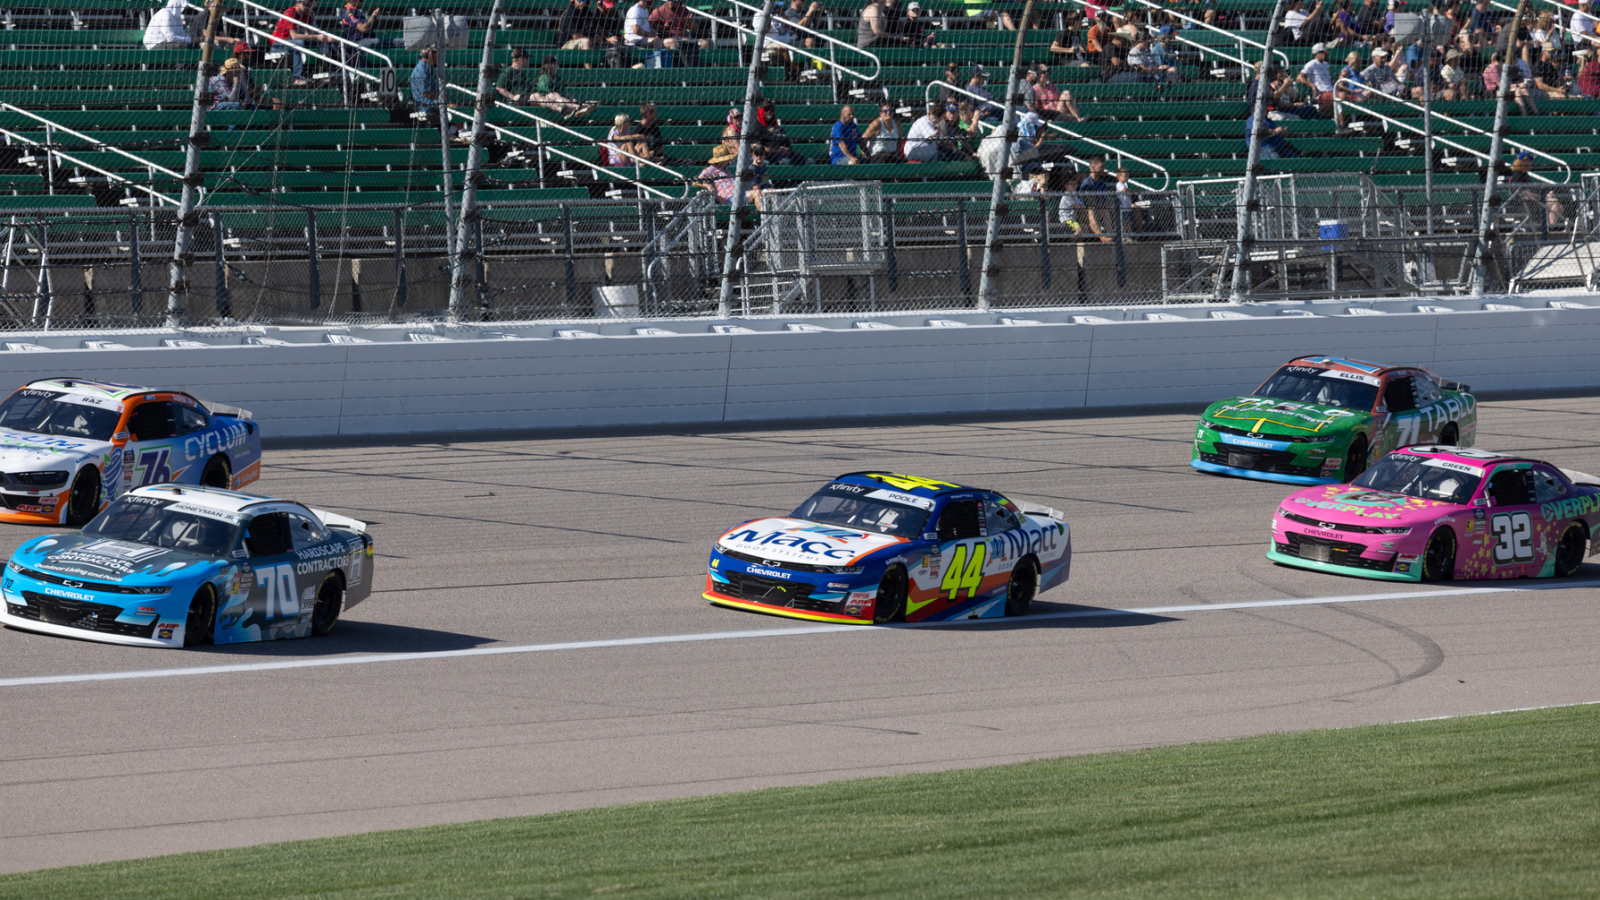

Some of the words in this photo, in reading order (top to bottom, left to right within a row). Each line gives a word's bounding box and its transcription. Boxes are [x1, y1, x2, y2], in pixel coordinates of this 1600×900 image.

[381, 70, 395, 92] 10
[1286, 365, 1318, 374] xfinity
[1339, 372, 1365, 381] ELLIS
[20, 389, 56, 399] xfinity
[82, 397, 103, 405] RAZ
[1265, 408, 1295, 416] WATCH
[1419, 392, 1476, 433] TABLO
[1397, 413, 1420, 447] 71
[184, 422, 248, 461] CYCLUM
[1232, 437, 1274, 449] CHEVROLET
[1389, 453, 1421, 462] xfinity
[137, 447, 172, 485] 76
[1442, 462, 1472, 472] GREEN
[829, 483, 865, 493] xfinity
[124, 495, 164, 506] xfinity
[888, 493, 918, 503] POOLE
[17, 504, 41, 512] ARP
[175, 504, 222, 518] HONEYMAN
[1294, 497, 1402, 520] OVERPLAY
[1303, 527, 1344, 540] CHEVROLET
[1491, 511, 1534, 563] 32
[727, 529, 855, 560] Macc
[1003, 524, 1057, 560] Macc
[295, 542, 346, 560] HARDSCAPE
[735, 543, 767, 551] DOOR
[771, 548, 820, 562] SYSTEMS
[47, 555, 136, 573] CONTRACTORS
[62, 551, 134, 568] HARDSCAPE
[297, 555, 350, 575] CONTRACTORS
[998, 561, 1013, 571] DOOR
[34, 563, 66, 572] Outdoor
[65, 566, 86, 575] Living
[102, 574, 123, 582] Pools
[746, 566, 792, 580] CHEVROLET
[940, 543, 986, 601] 44
[4, 577, 14, 588] 70
[44, 587, 95, 601] CHEVROLET
[254, 561, 300, 620] 70
